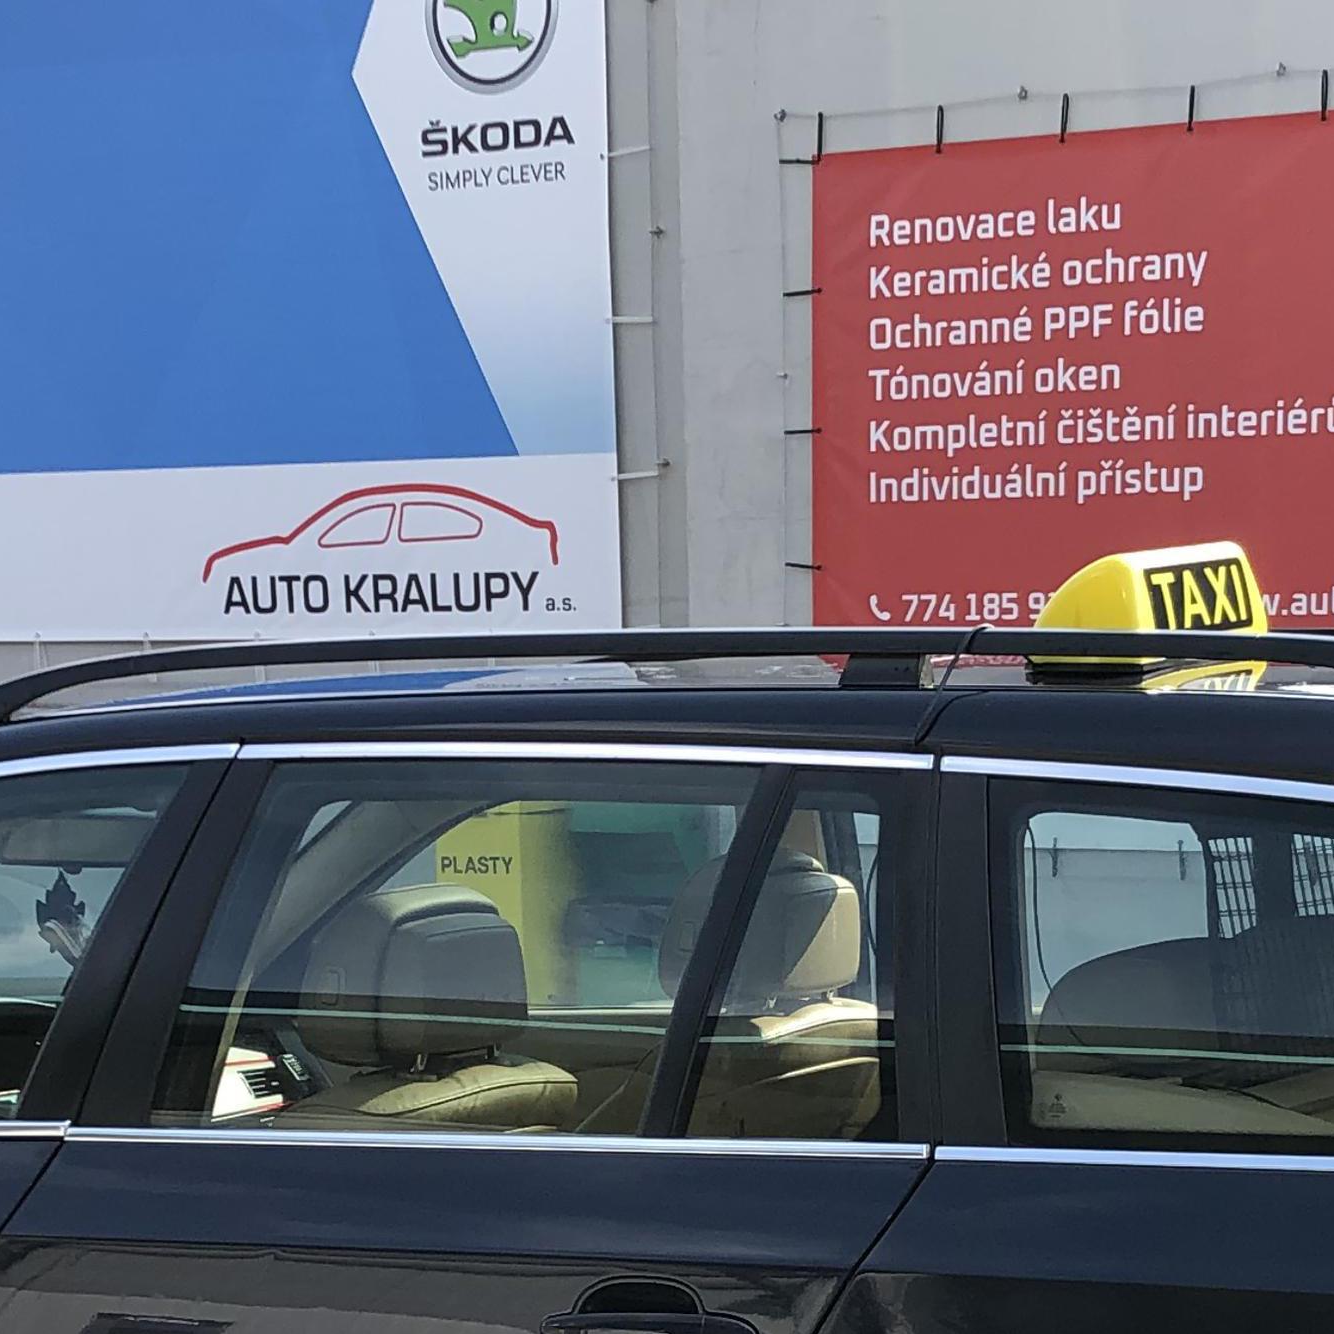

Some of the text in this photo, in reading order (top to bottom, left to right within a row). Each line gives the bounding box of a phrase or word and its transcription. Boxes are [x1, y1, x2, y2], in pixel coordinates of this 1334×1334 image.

[421, 115, 575, 158] ŠKODA
[428, 161, 566, 191] SIMPLY CLEVER
[868, 196, 1122, 249] Renovace laku
[868, 247, 1209, 300] Keramické ochrany
[868, 296, 1206, 351] Ochranné PPF fólie
[867, 356, 1122, 402] Tónování oken
[868, 409, 1047, 458] Kompletní
[1056, 402, 1178, 446] čištění
[868, 458, 1206, 505] Individuální přístup
[224, 571, 577, 615] AUTO KRALUPY a.s.
[901, 592, 957, 622] 774
[965, 592, 1019, 621] 185
[1149, 562, 1249, 632] TAXI
[440, 856, 513, 875] PLASTY
